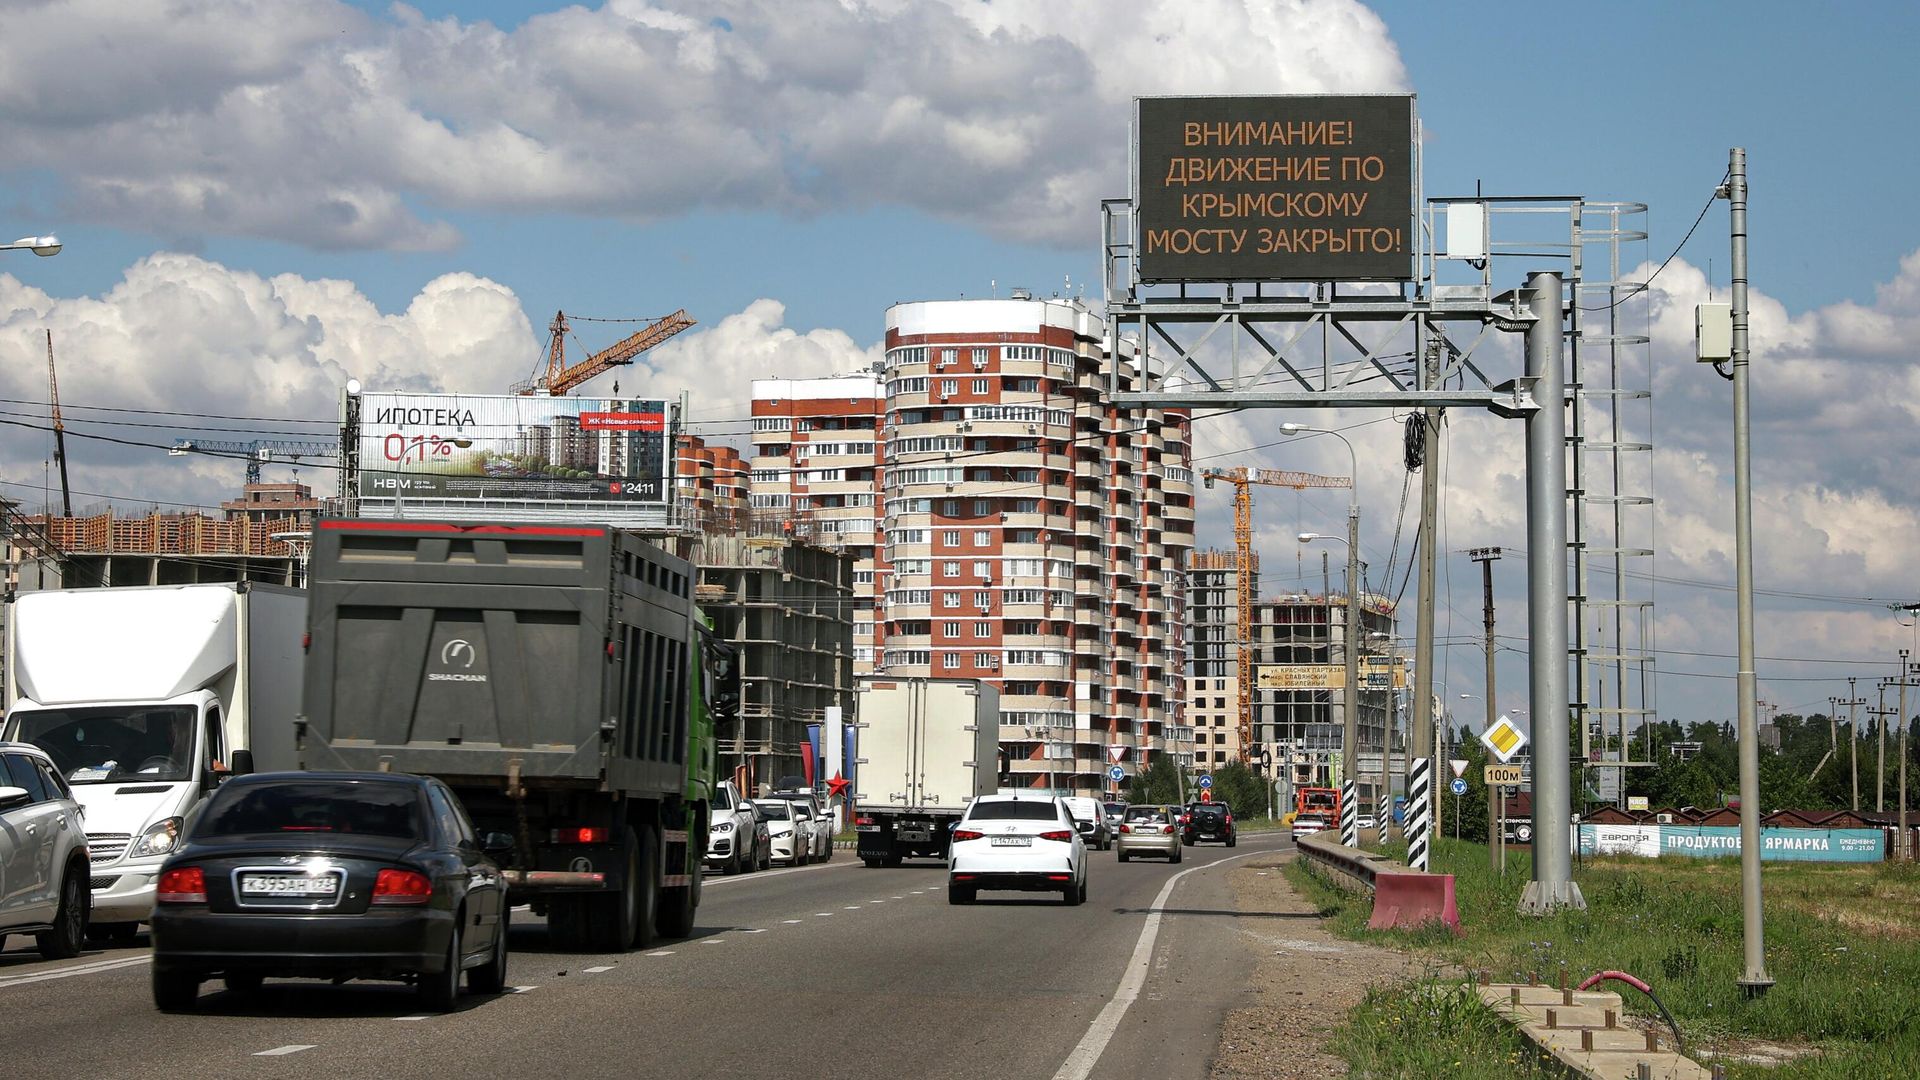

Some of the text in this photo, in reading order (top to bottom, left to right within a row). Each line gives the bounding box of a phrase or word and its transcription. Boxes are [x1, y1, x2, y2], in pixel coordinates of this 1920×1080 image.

[1184, 121, 1353, 146] ВНИМАНИЕ!
[1165, 156, 1385, 186] ДВИЖЕНИЕ ПО
[1183, 193, 1368, 218] КРЫМСКОМУ
[1148, 228, 1401, 254] МОСТУ ЗАКРЫТО!
[377, 407, 475, 426] ИПОТЕКА
[1488, 769, 1519, 781] 100м
[1765, 837, 1829, 850] ЯРМАРКА
[1840, 838, 1876, 846] ЕЖЕДНЕВНО
